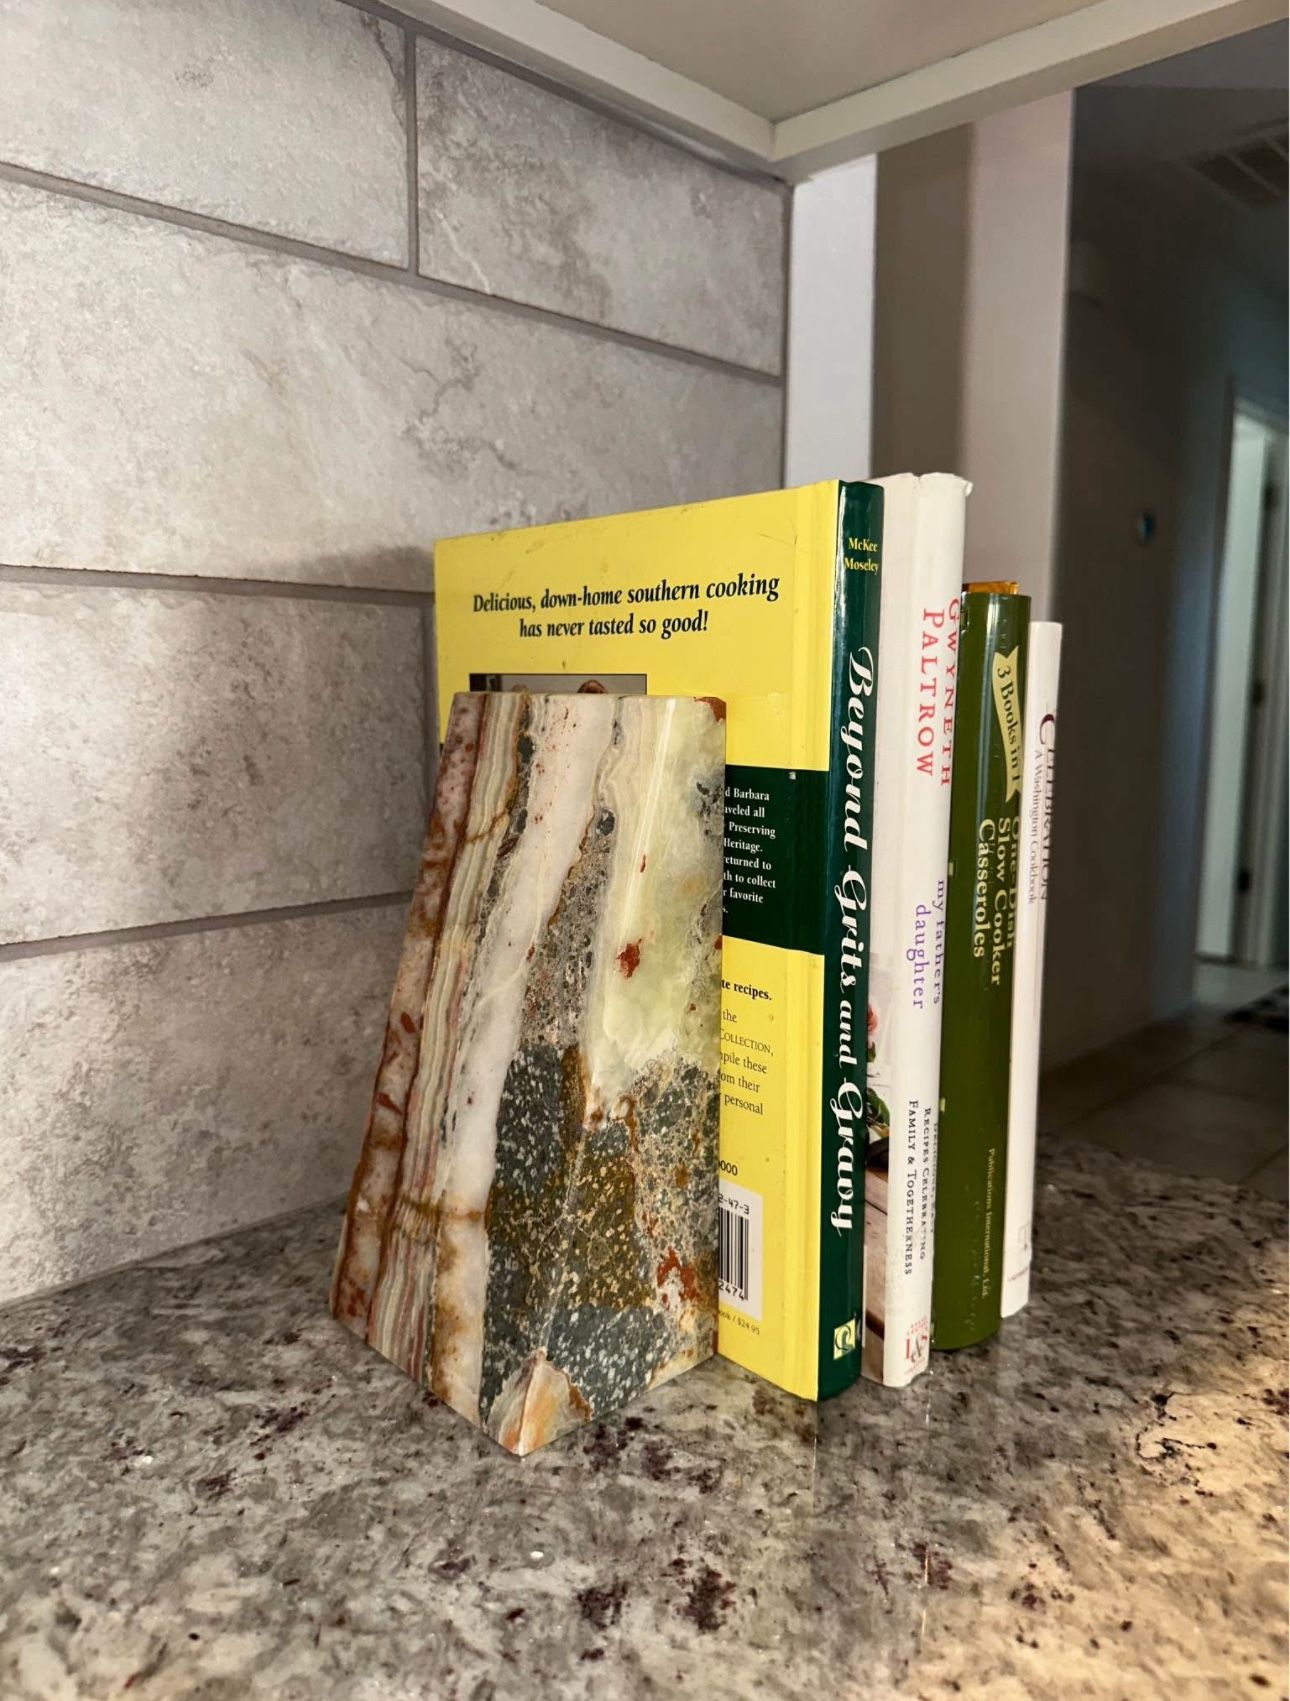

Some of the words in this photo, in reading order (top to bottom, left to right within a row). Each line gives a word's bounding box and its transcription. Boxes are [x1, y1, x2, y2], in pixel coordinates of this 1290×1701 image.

[848, 537, 879, 552] McKee
[844, 557, 879, 575] Moseley
[473, 592, 536, 612] Delicious,
[541, 585, 622, 608] down-home
[627, 579, 700, 603] southern
[706, 573, 780, 602] cooking
[520, 618, 542, 637] has
[547, 622, 585, 637] never
[589, 613, 634, 635] tasted
[639, 617, 656, 634] so
[661, 609, 708, 640] good!
[997, 666, 1011, 679] 3
[916, 608, 945, 776] PALTROW
[941, 598, 960, 785] GWYNETH
[1000, 682, 1020, 746] Books
[840, 646, 874, 852] Beyond
[1011, 746, 1021, 765] in
[1034, 750, 1043, 760] A
[733, 787, 770, 801] Barbara
[1028, 763, 1042, 837] Washington
[724, 804, 750, 817] veled
[753, 806, 765, 818] all
[729, 821, 776, 840] Preserving
[723, 837, 763, 854] Heritage.
[995, 817, 1011, 881] Slow
[724, 856, 760, 869] eturned
[762, 861, 772, 870] to
[1028, 840, 1039, 904] Cookbook
[735, 873, 745, 883] to
[747, 875, 776, 889] collect
[973, 818, 995, 958] Casseroles
[729, 887, 764, 904] favorite
[932, 880, 945, 912] my
[834, 865, 867, 994] Grits
[991, 889, 1008, 986] Cooker
[906, 903, 932, 1010] daughter
[733, 983, 772, 1000] recipes.
[722, 1009, 738, 1023] the
[839, 1000, 858, 1068] and
[720, 1051, 740, 1066] pile
[743, 1056, 768, 1074] these
[738, 1075, 760, 1093] their
[724, 1093, 764, 1116] personal
[908, 1100, 919, 1147] FAMILY
[923, 1107, 932, 1163] RECIPES
[718, 1160, 738, 1176] 000
[830, 1077, 863, 1237] Gravy
[907, 1156, 915, 1165] &
[718, 1193, 750, 1215] 2-47-3
[904, 1169, 918, 1275] TOGETHERNESS
[719, 1279, 745, 1301] 2474
